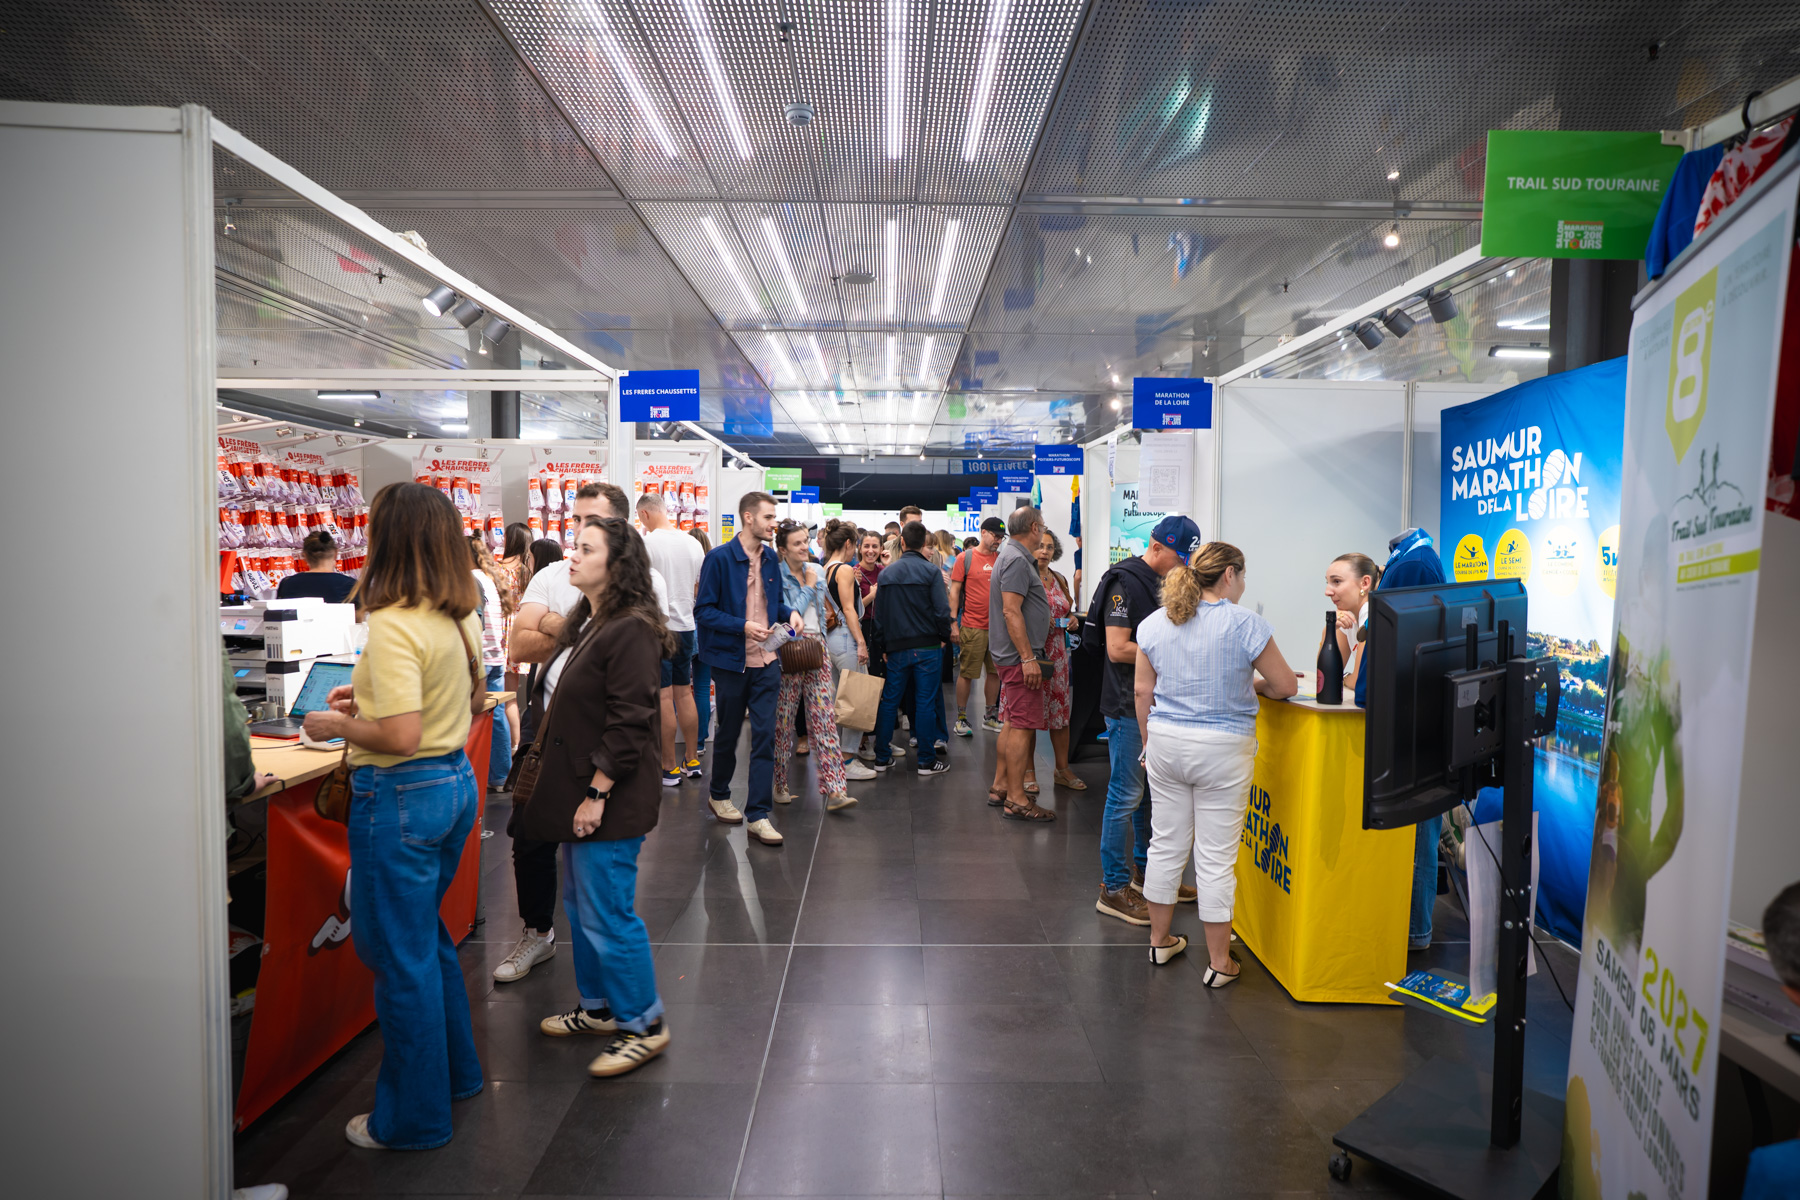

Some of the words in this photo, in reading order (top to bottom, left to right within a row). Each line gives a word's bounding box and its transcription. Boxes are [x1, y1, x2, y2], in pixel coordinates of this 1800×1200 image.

[1507, 177, 1548, 190] TRAIL
[1552, 177, 1582, 190] SUD
[1586, 178, 1661, 192] TOURAINE
[1556, 220, 1564, 249] SALON
[1564, 231, 1575, 239] 10
[1584, 231, 1602, 240] 20K
[1564, 238, 1602, 249] TOURS
[225, 438, 236, 446] LES
[1452, 426, 1542, 472] SAUMUR
[1452, 448, 1582, 500] MARATHON
[1123, 490, 1138, 500] MA
[1516, 486, 1590, 522] LOIRE
[1672, 520, 1692, 542] Trail
[1692, 515, 1707, 538] Sud
[1709, 502, 1753, 532] Touraine
[1254, 840, 1291, 895] LOIRE
[1592, 998, 1609, 1041] POUR
[1596, 939, 1636, 1018] SAMEDI
[1640, 1005, 1656, 1046] 06
[1660, 1034, 1700, 1122] MARS
[1642, 947, 1709, 1076] 2027
[1613, 1005, 1663, 1104] QUALIFICATIF
